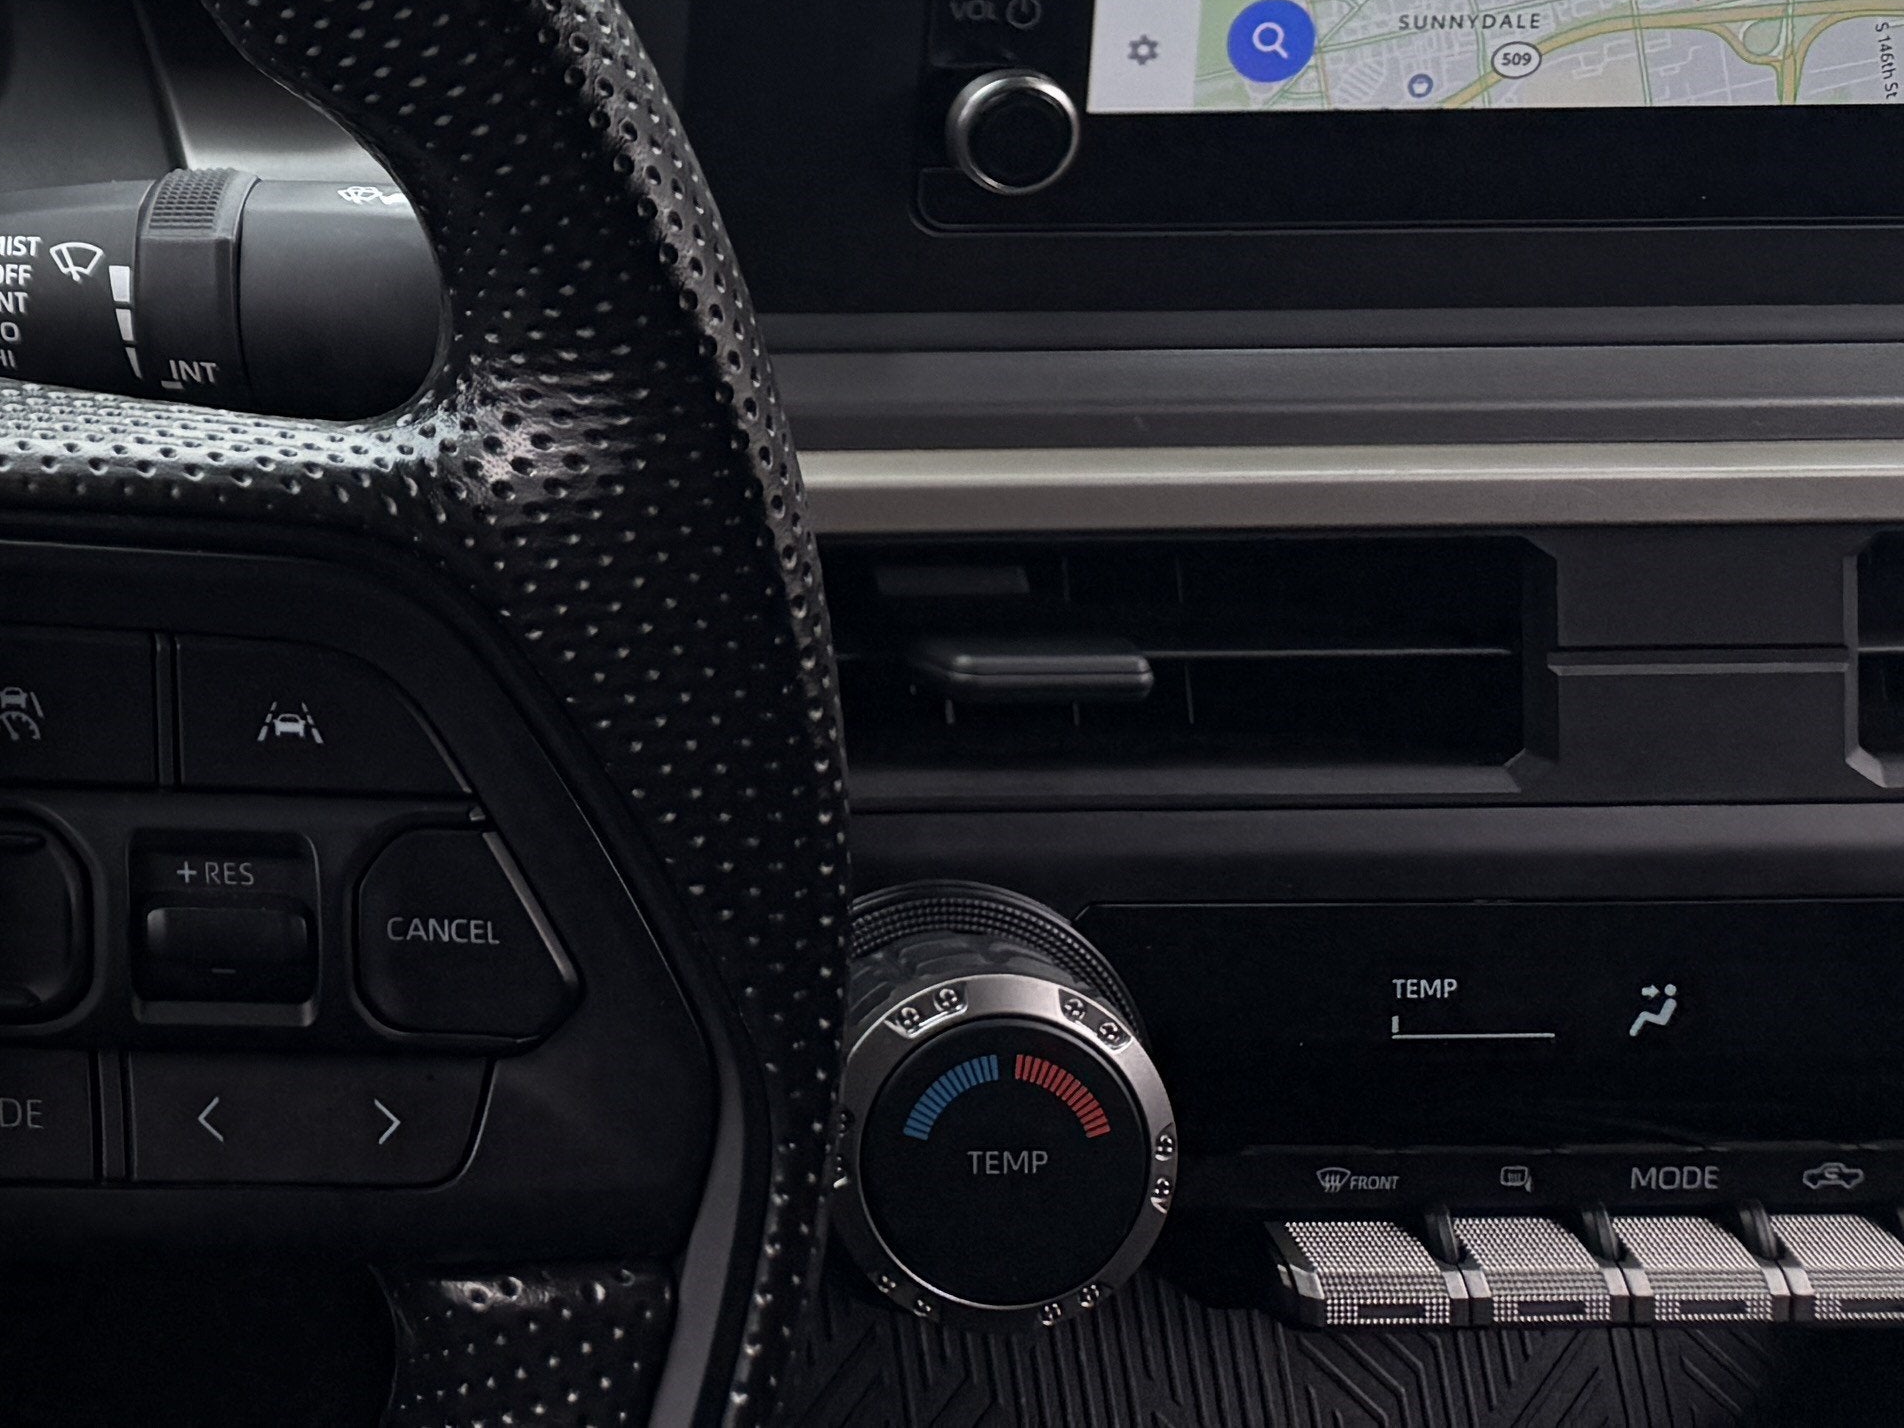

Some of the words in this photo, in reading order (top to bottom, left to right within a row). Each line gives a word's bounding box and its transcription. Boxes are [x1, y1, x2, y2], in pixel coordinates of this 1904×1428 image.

[1398, 13, 1541, 30] SUNNYDALE
[1875, 21, 1889, 33] S
[1500, 52, 1532, 67] 509
[1877, 35, 1898, 80] 146th
[1884, 82, 1899, 100] St
[168, 358, 218, 383] INT
[386, 916, 501, 945] CANCEL
[1392, 978, 1458, 999] TEMP
[966, 1150, 1049, 1175] TEMP
[1349, 1175, 1400, 1190] FRONT
[1630, 1166, 1720, 1190] MODE
